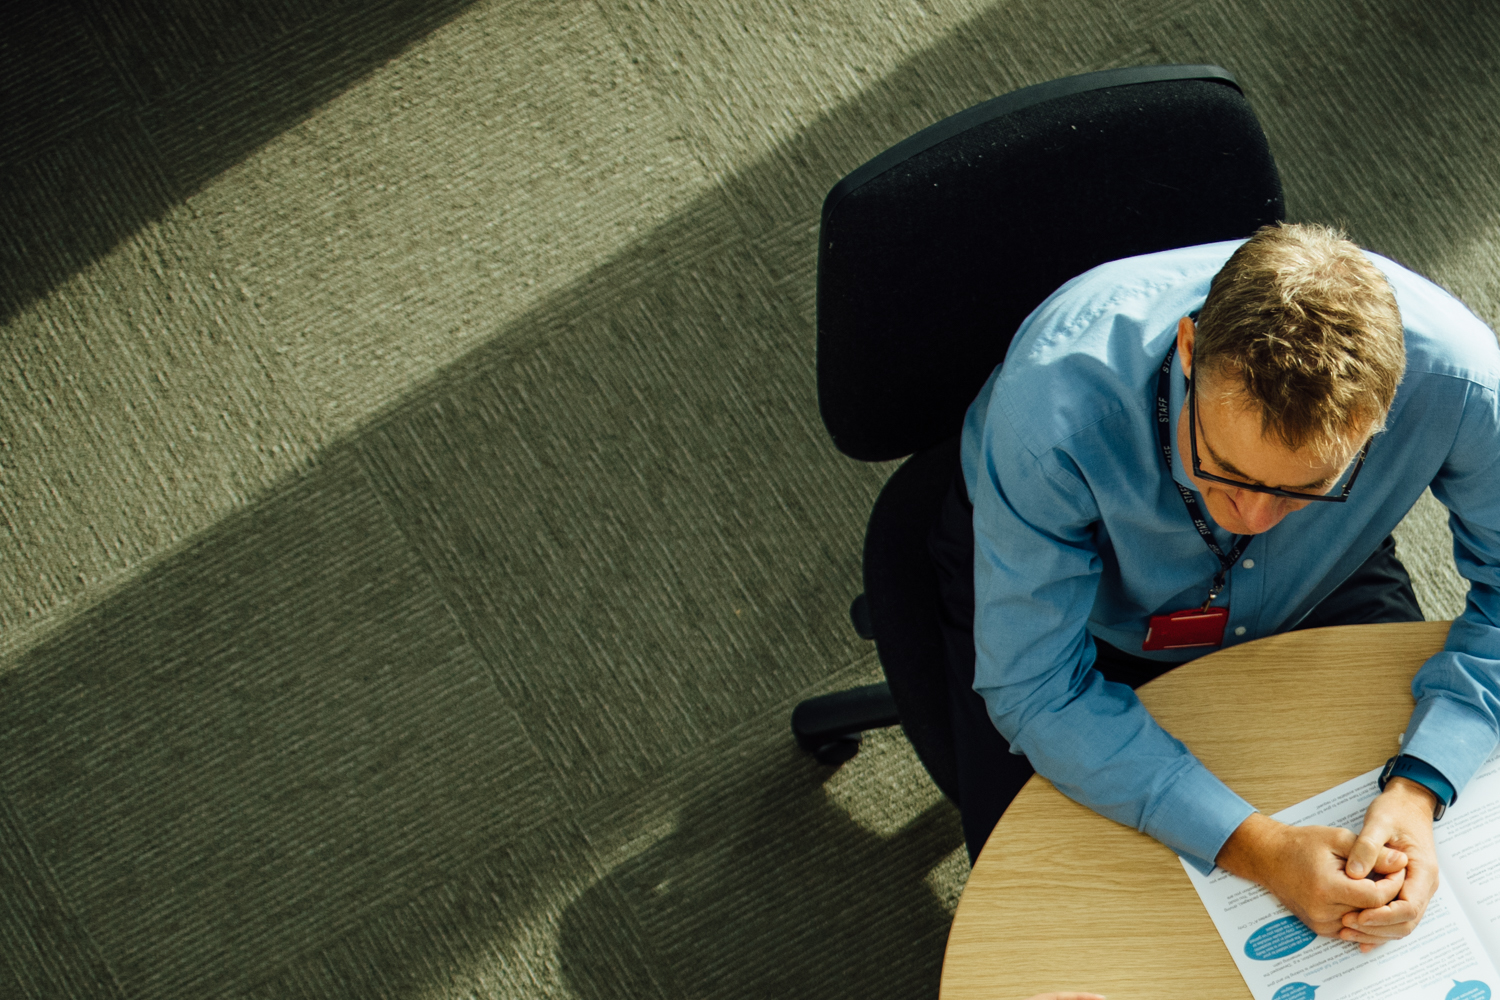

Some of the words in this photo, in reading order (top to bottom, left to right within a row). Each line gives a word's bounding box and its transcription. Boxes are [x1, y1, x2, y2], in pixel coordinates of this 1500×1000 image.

[1158, 397, 1169, 423] STAFF
[1163, 445, 1172, 467] TAFF
[1195, 519, 1210, 535] STAFF
[1279, 983, 1295, 994] degree
